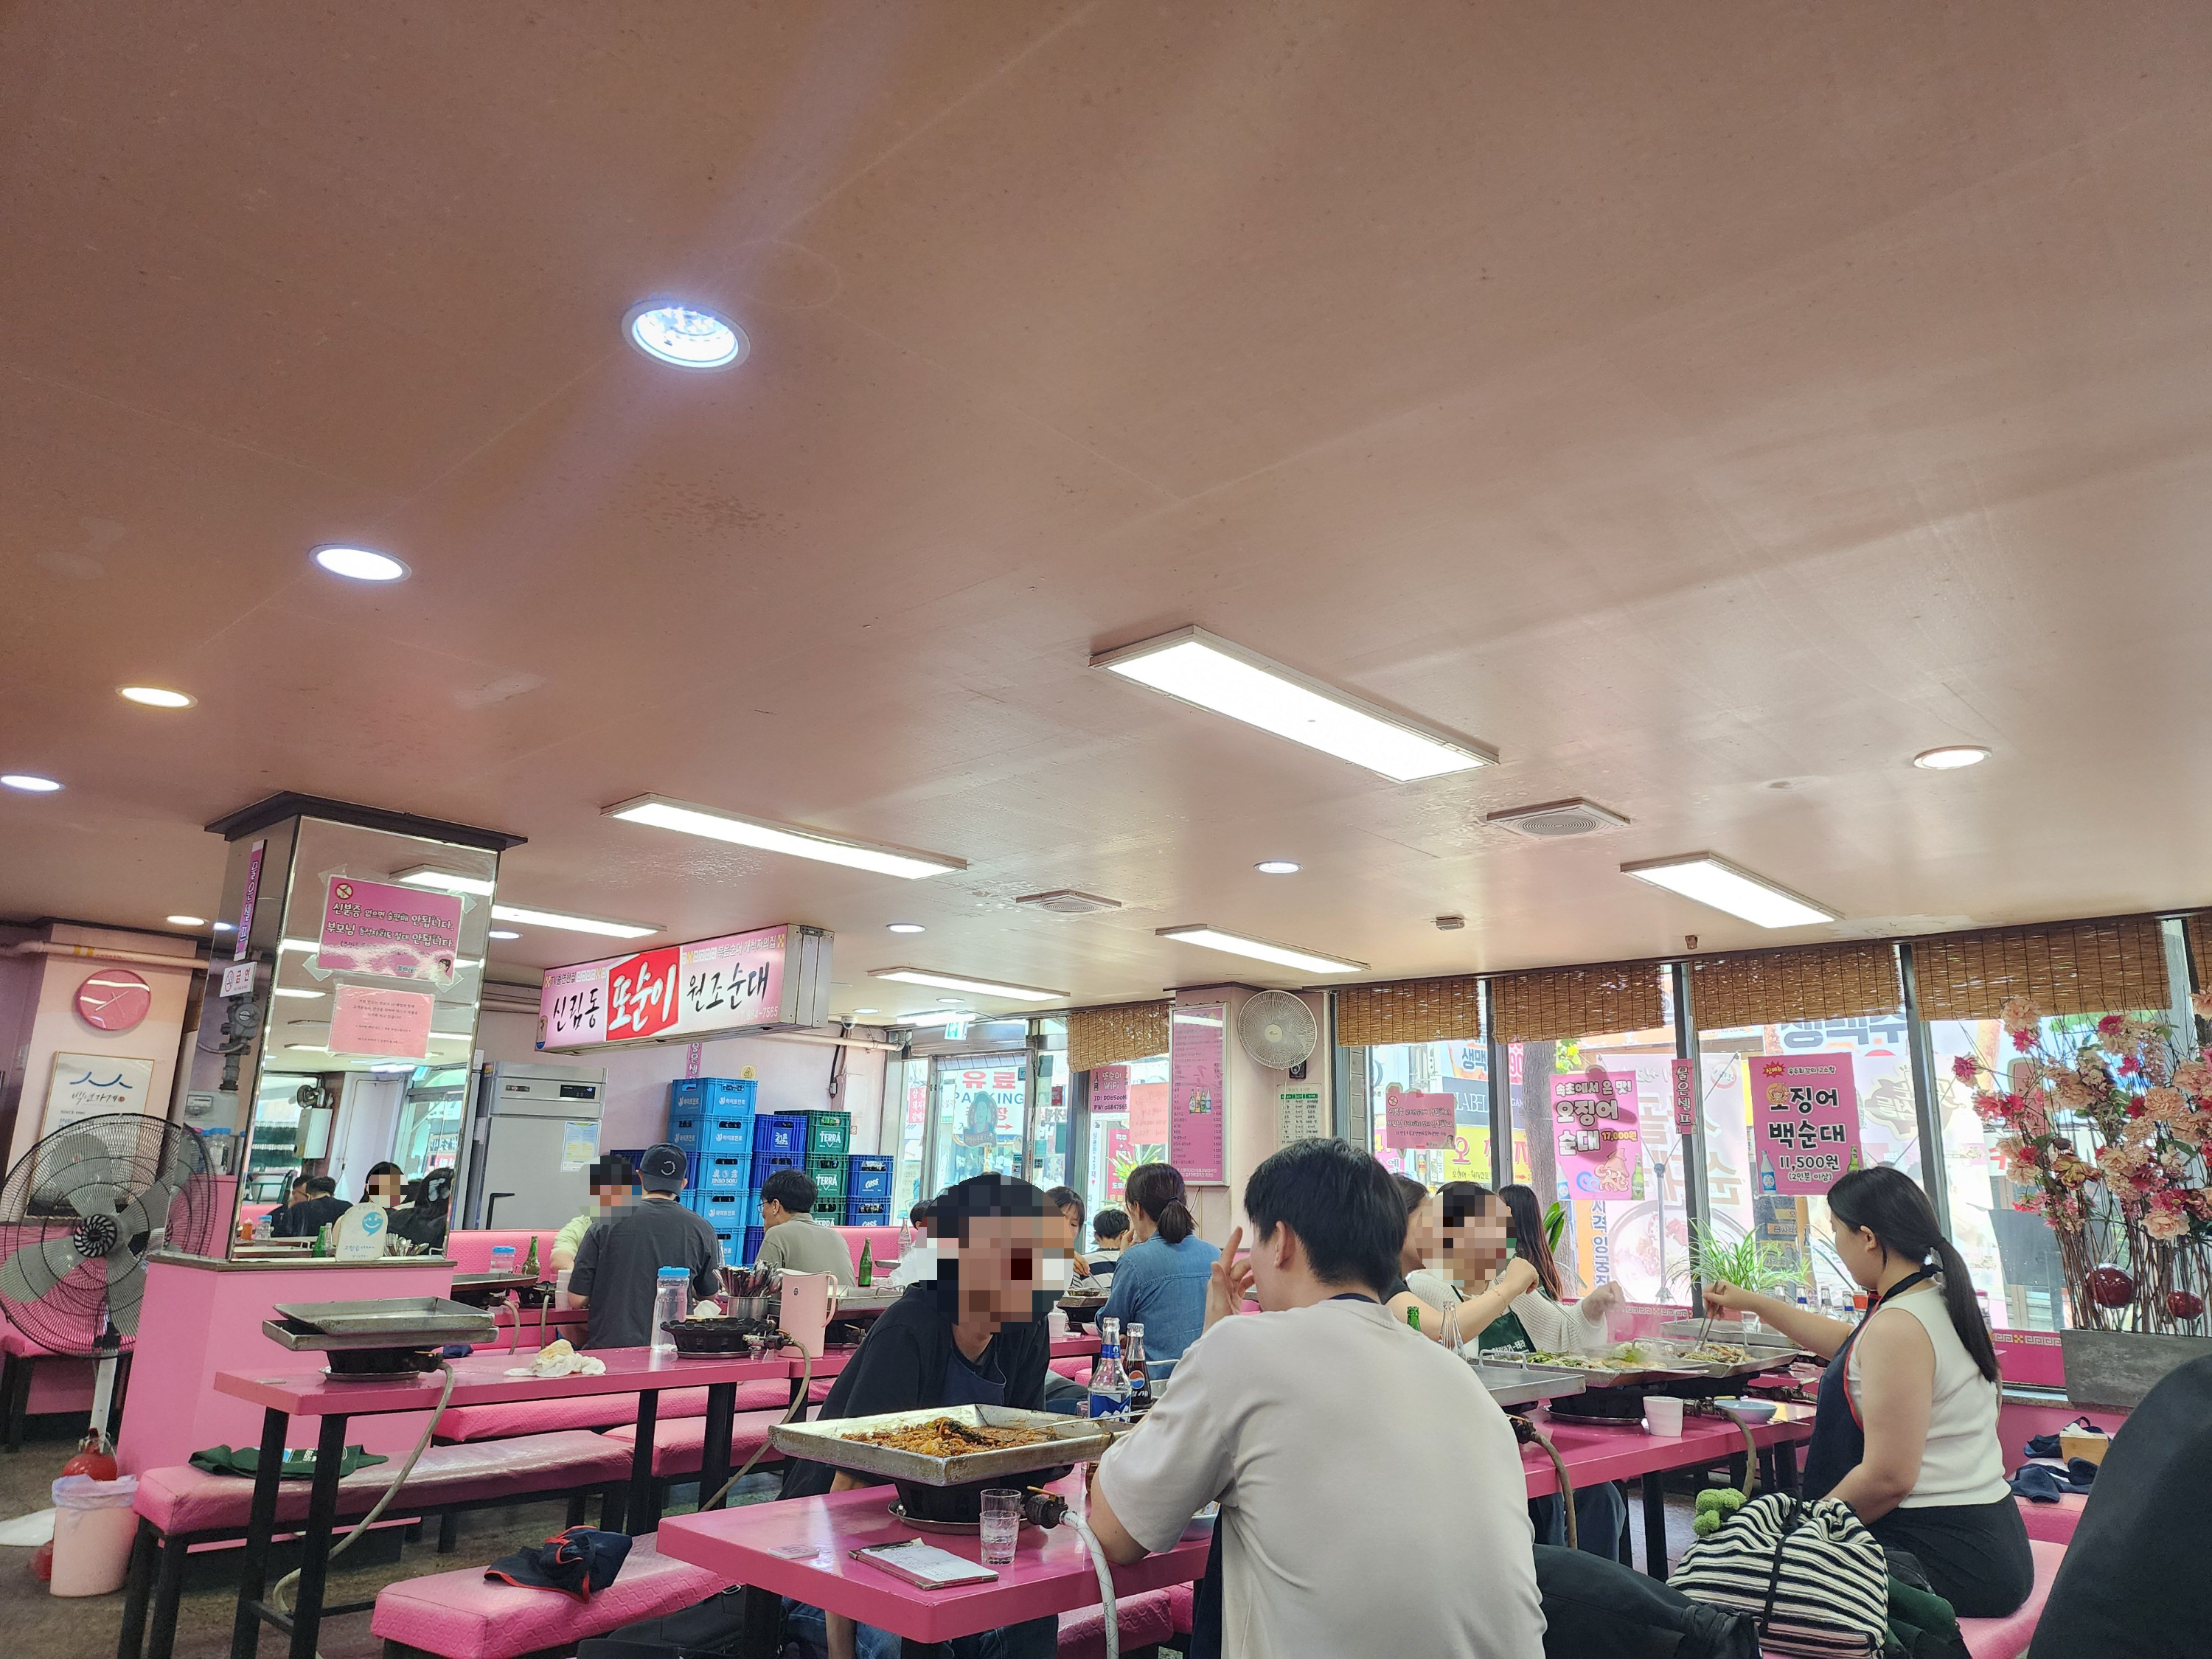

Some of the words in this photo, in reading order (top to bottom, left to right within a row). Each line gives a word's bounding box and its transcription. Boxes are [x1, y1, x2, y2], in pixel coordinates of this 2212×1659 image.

[333, 902, 361, 918] 신분증
[364, 909, 386, 919] 없으면
[387, 912, 408, 922] 술판매
[411, 915, 454, 931] 안됩니다.
[326, 922, 356, 936] 부모님
[358, 927, 392, 939] 동석자리도
[394, 932, 409, 941] 절대
[411, 933, 455, 950] 안됩니다.
[552, 987, 600, 1032] 신림동
[608, 961, 676, 1033] 또순이
[962, 1071, 1016, 1090] 유료
[1102, 1071, 1121, 1080] 또순이
[1104, 1081, 1119, 1090] WiFi
[1556, 1080, 1600, 1097] 속초에서
[1602, 1080, 1613, 1096] 온
[1676, 1066, 1691, 1126] 물은셀프
[1556, 1099, 1619, 1127] 오징어
[723, 1134, 742, 1142] 하이트진로
[819, 1133, 841, 1144] TERRA
[1558, 1129, 1601, 1156] 순대
[1601, 1130, 1638, 1142] 17,000원
[1768, 1119, 1846, 1150] 백순대
[1780, 1154, 1840, 1172] 11,500원
[815, 1175, 838, 1186] TERRA
[1787, 1172, 1812, 1182] (2인분
[1813, 1172, 1833, 1183] 이상)
